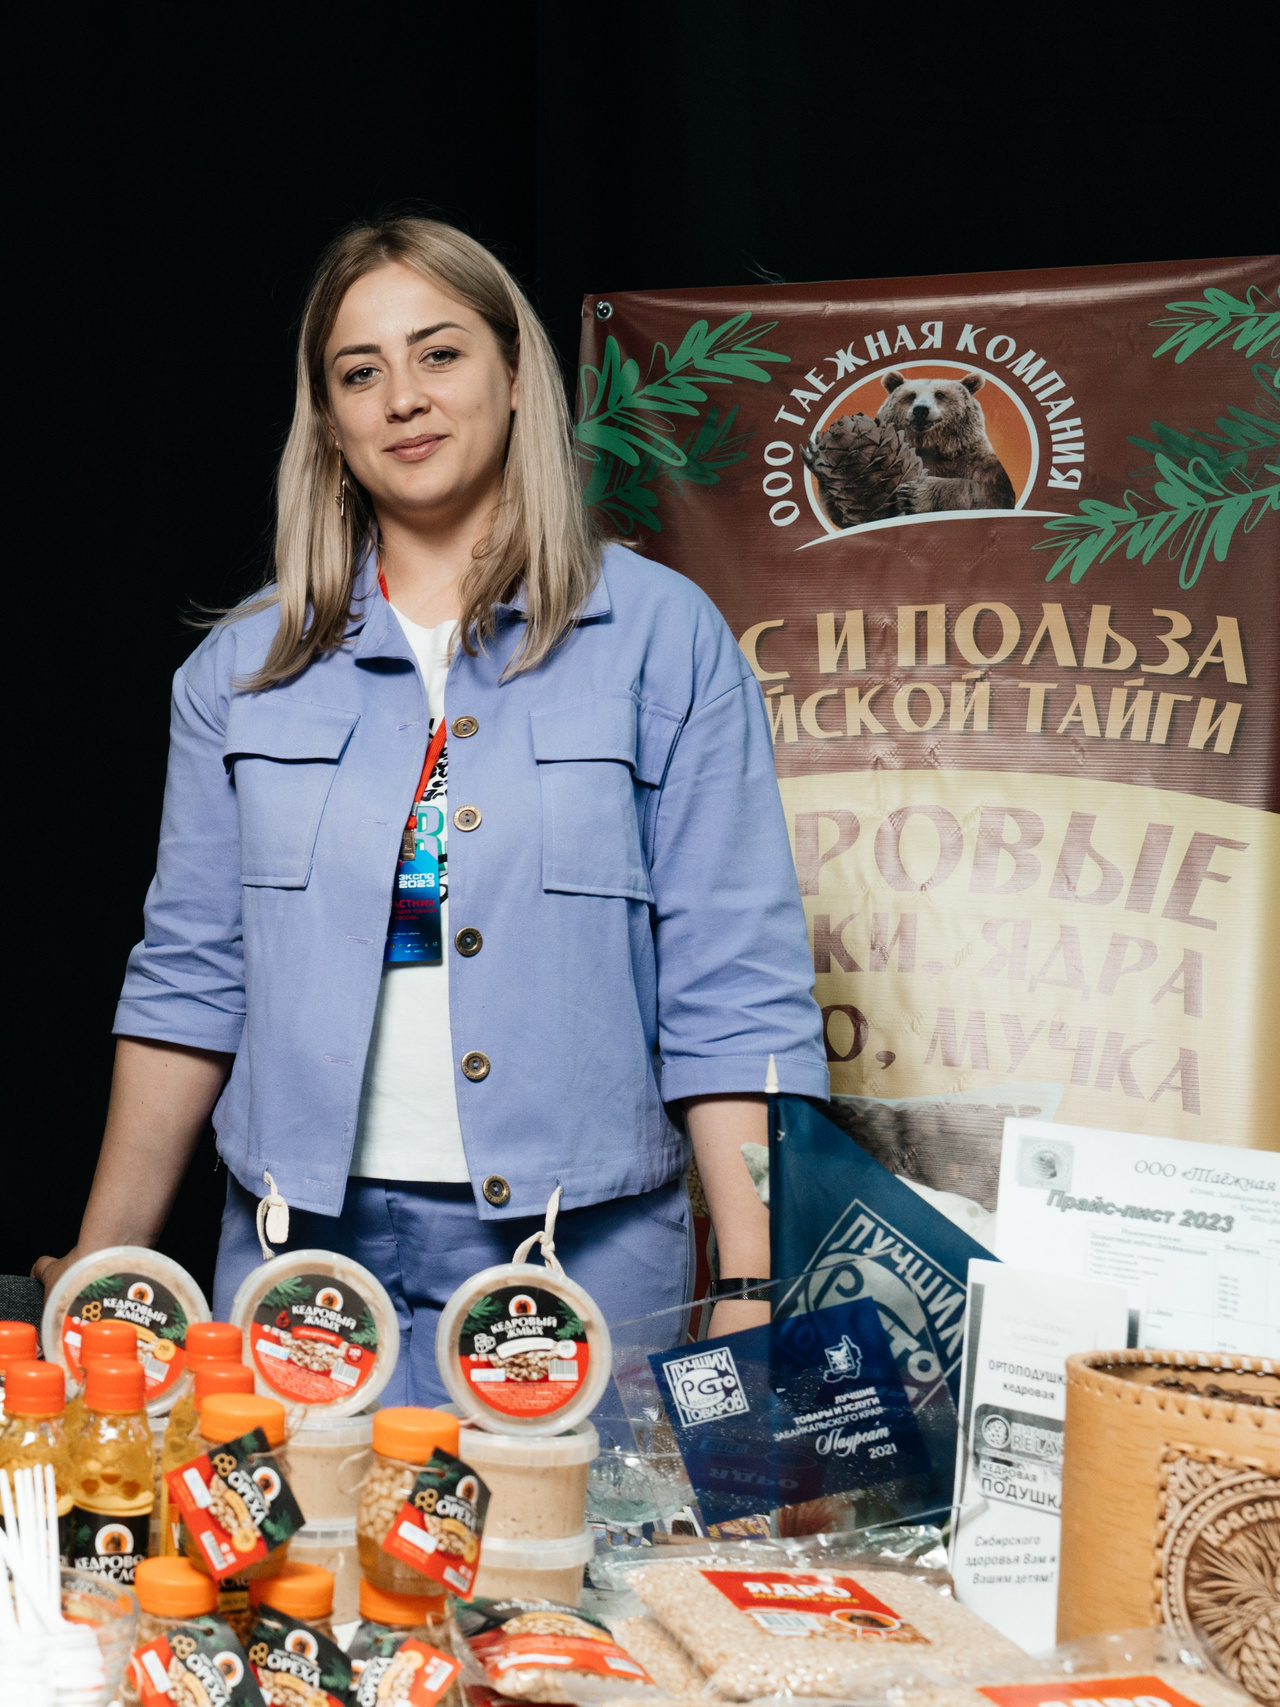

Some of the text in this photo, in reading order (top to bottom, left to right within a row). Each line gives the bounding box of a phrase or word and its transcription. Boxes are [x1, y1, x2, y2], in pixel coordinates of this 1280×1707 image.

[762, 320, 1086, 528] ООО ТАЕЖНАЯ КОМПАНИЯ
[817, 608, 869, 673] И
[896, 601, 1248, 686] ПОЛЬЗА
[1018, 677, 1244, 756] ТАЙГИ
[398, 872, 435, 880] ЭКСПО
[398, 880, 436, 889] 2023
[975, 917, 1204, 1019] ЯДРА
[924, 1006, 1204, 1116] МУЧКА
[1134, 1159, 1177, 1178] ООО
[1046, 1188, 1176, 1224] Прайс-лист
[1178, 1208, 1236, 1233] 2023
[103, 1297, 168, 1325] КЕДРОВЫЙ
[114, 1307, 152, 1328] ЖМЫХ
[291, 1304, 358, 1331] КЕДРОВЫЙ
[303, 1312, 342, 1333] ЖМЫХ
[490, 1315, 558, 1335] КЕДРОВЫЙ
[506, 1325, 544, 1339] ЖМЫХ
[834, 1386, 877, 1405] ЛУЧШИЕ
[1002, 1381, 1057, 1402] кедровая
[792, 1407, 835, 1426] ТОВАРЫ
[842, 1396, 880, 1415] УСЛУГИ
[773, 1406, 885, 1443] ЗАБАЙКАЛЬСКОГО КРАЯ
[815, 1426, 891, 1458] Лауреат
[867, 1443, 899, 1460] 2021
[981, 1462, 1038, 1483] КЕДРОВАЯ
[981, 1476, 1062, 1509] ПОДУШК
[974, 1534, 1041, 1549] Сибирского
[965, 1554, 1020, 1567] здоровья
[1023, 1553, 1046, 1565] Вам
[972, 1572, 1054, 1586] Вашим детям!
[742, 1581, 852, 1599] ЯДРО
